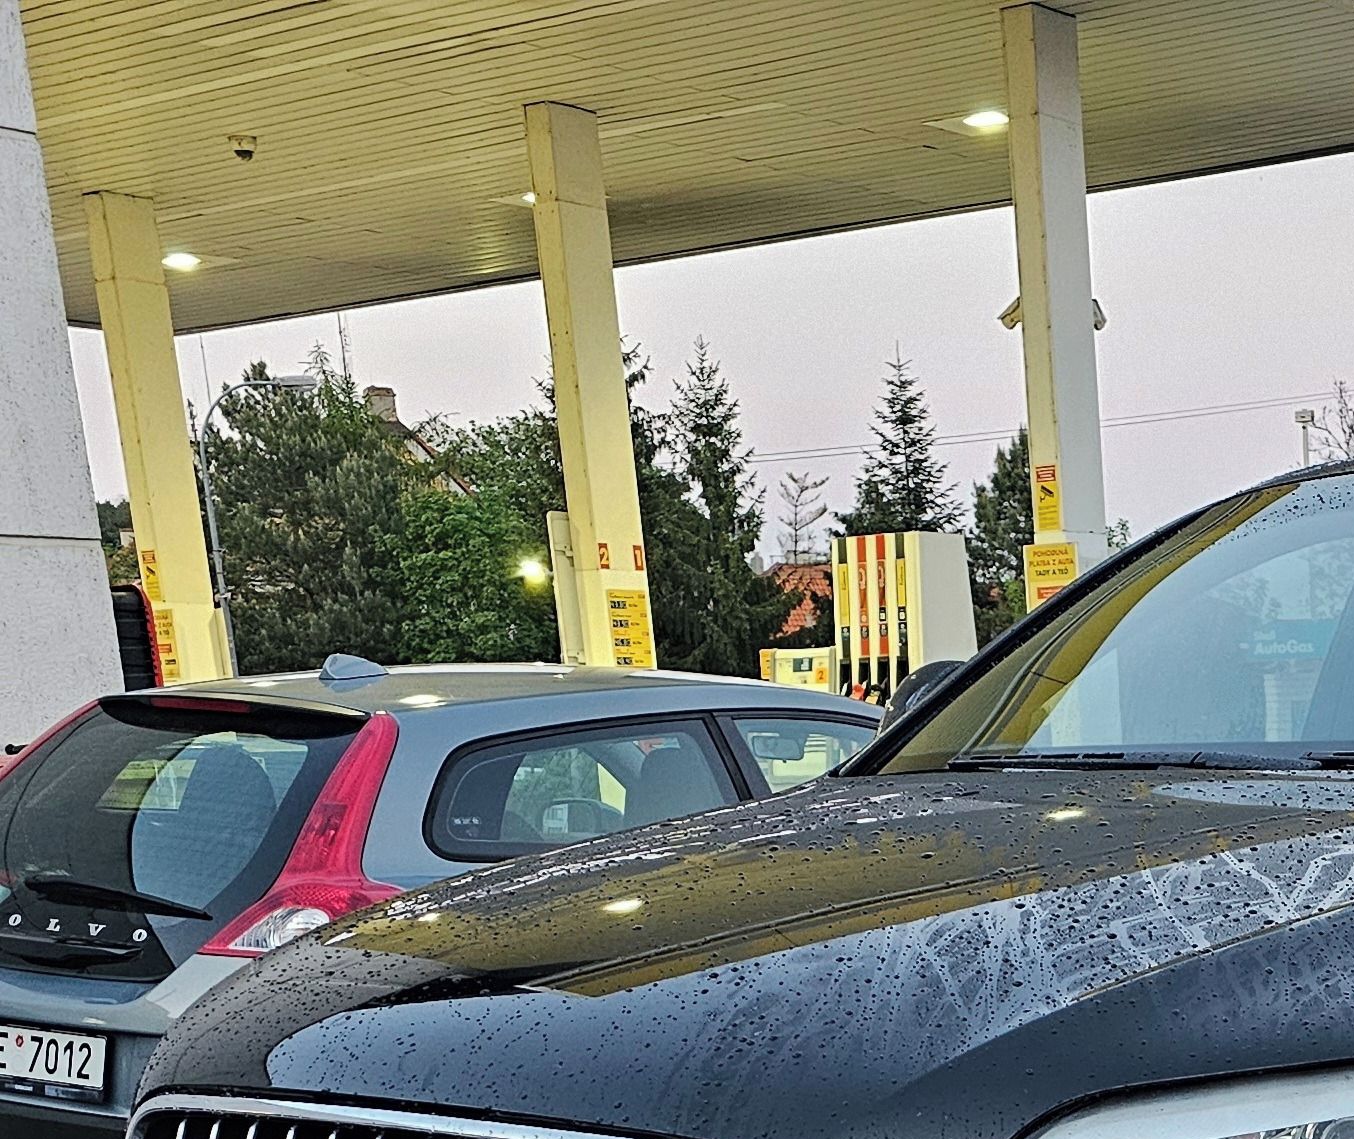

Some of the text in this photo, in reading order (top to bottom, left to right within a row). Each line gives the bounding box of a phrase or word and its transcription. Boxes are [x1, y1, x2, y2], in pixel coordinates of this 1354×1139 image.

[599, 547, 610, 565] 2
[634, 548, 642, 567] 1
[1254, 639, 1314, 655] AutoGas
[28, 1035, 92, 1080] 7012
